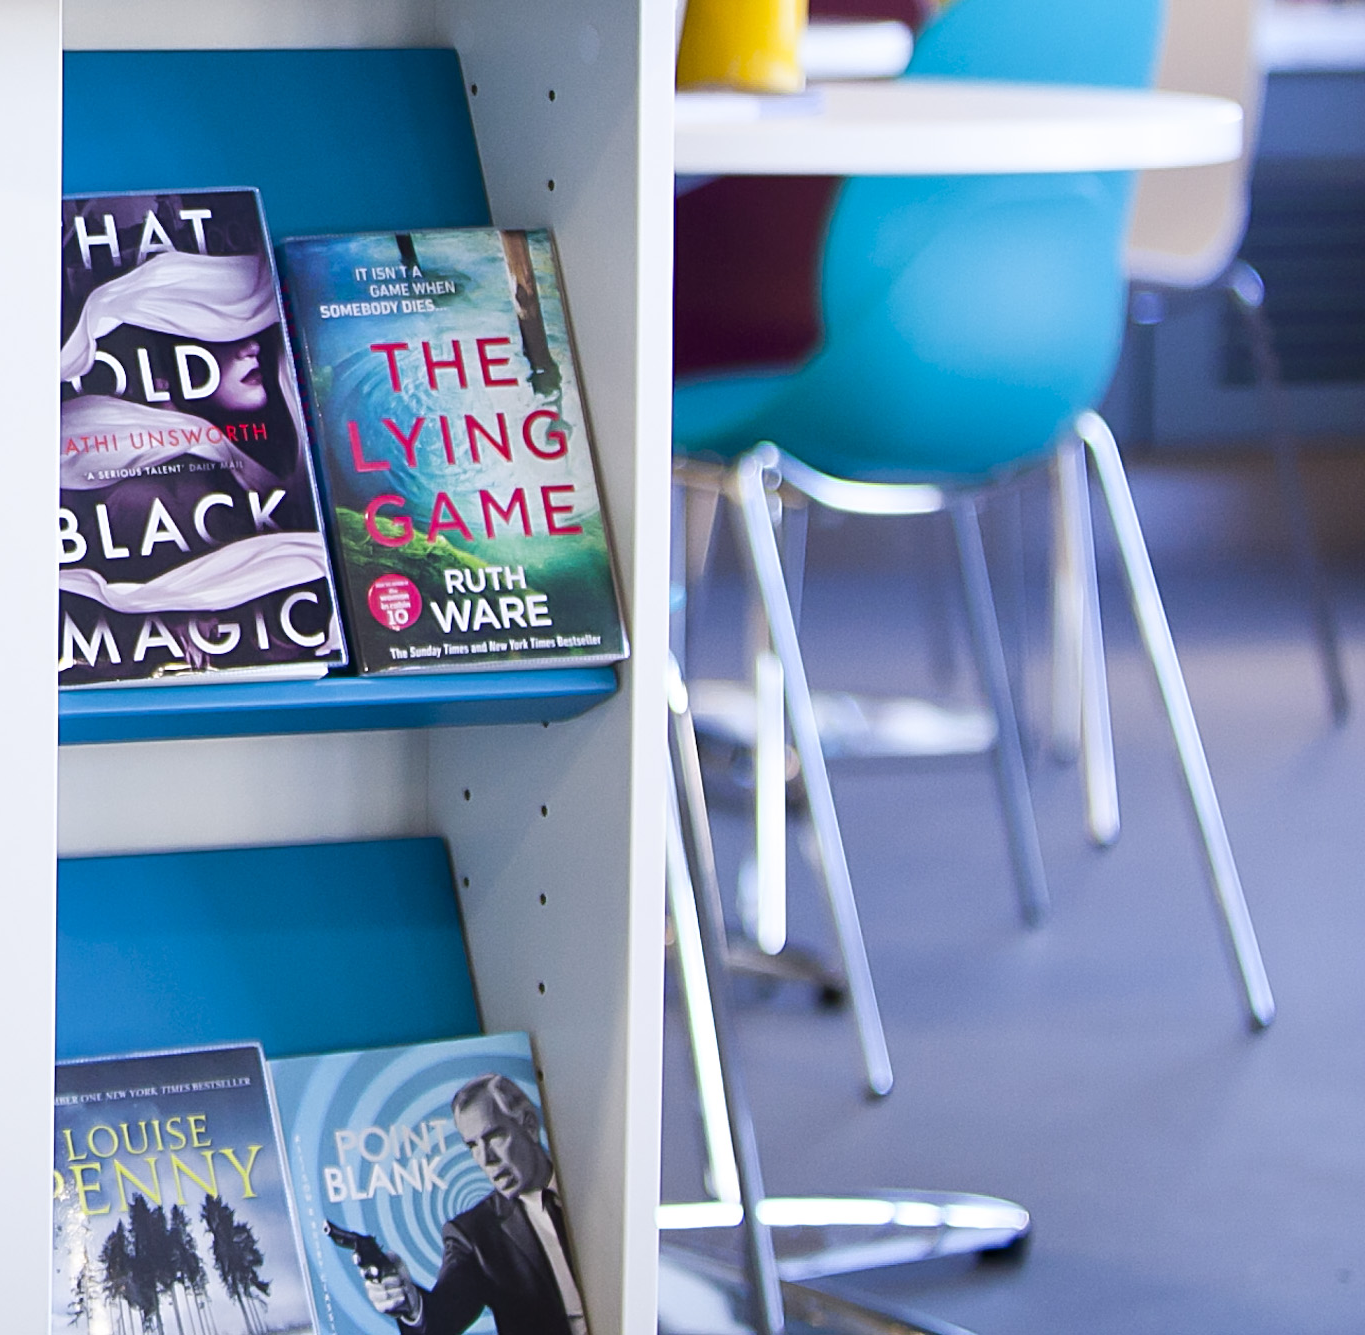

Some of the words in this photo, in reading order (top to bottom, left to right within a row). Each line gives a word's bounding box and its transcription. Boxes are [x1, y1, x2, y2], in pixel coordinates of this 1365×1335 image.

[61, 209, 212, 269] HAT
[355, 267, 368, 281] IT
[371, 265, 408, 281] ISN'T
[412, 265, 423, 278] A
[369, 282, 410, 298] GAME
[411, 280, 456, 295] WHEN
[319, 300, 399, 319] SOMEBODY
[401, 298, 447, 314] DIES...
[71, 345, 221, 403] OLD
[370, 337, 519, 393] THE
[63, 433, 118, 456] ATHI
[130, 422, 268, 450] UNSWORTH
[347, 409, 569, 473] LYING
[98, 467, 142, 481] SERIOUS
[144, 464, 185, 476] TALENT'
[188, 462, 216, 473] DAILY
[219, 461, 244, 471] MAIL
[59, 489, 287, 564] BLACK
[364, 484, 583, 548] GAME
[444, 565, 528, 595] RUTH
[59, 591, 326, 671] MAGIC
[387, 609, 409, 625] 10
[430, 594, 553, 634] WARE
[390, 647, 408, 659] The
[410, 645, 442, 659] Sunday
[443, 643, 470, 655] Times
[471, 641, 488, 654] and
[489, 640, 508, 652] New
[509, 638, 529, 651] York
[530, 637, 556, 649] Times
[556, 634, 602, 648] Bestseller
[80, 1092, 102, 1104] ONE
[105, 1090, 126, 1101] NEW
[129, 1087, 159, 1098] YORK
[161, 1083, 191, 1095] TIMES
[191, 1077, 252, 1092] BESTSELLER
[62, 1114, 212, 1162] LOUISE
[336, 1119, 447, 1166] POINT
[324, 1156, 449, 1203] BLANK
